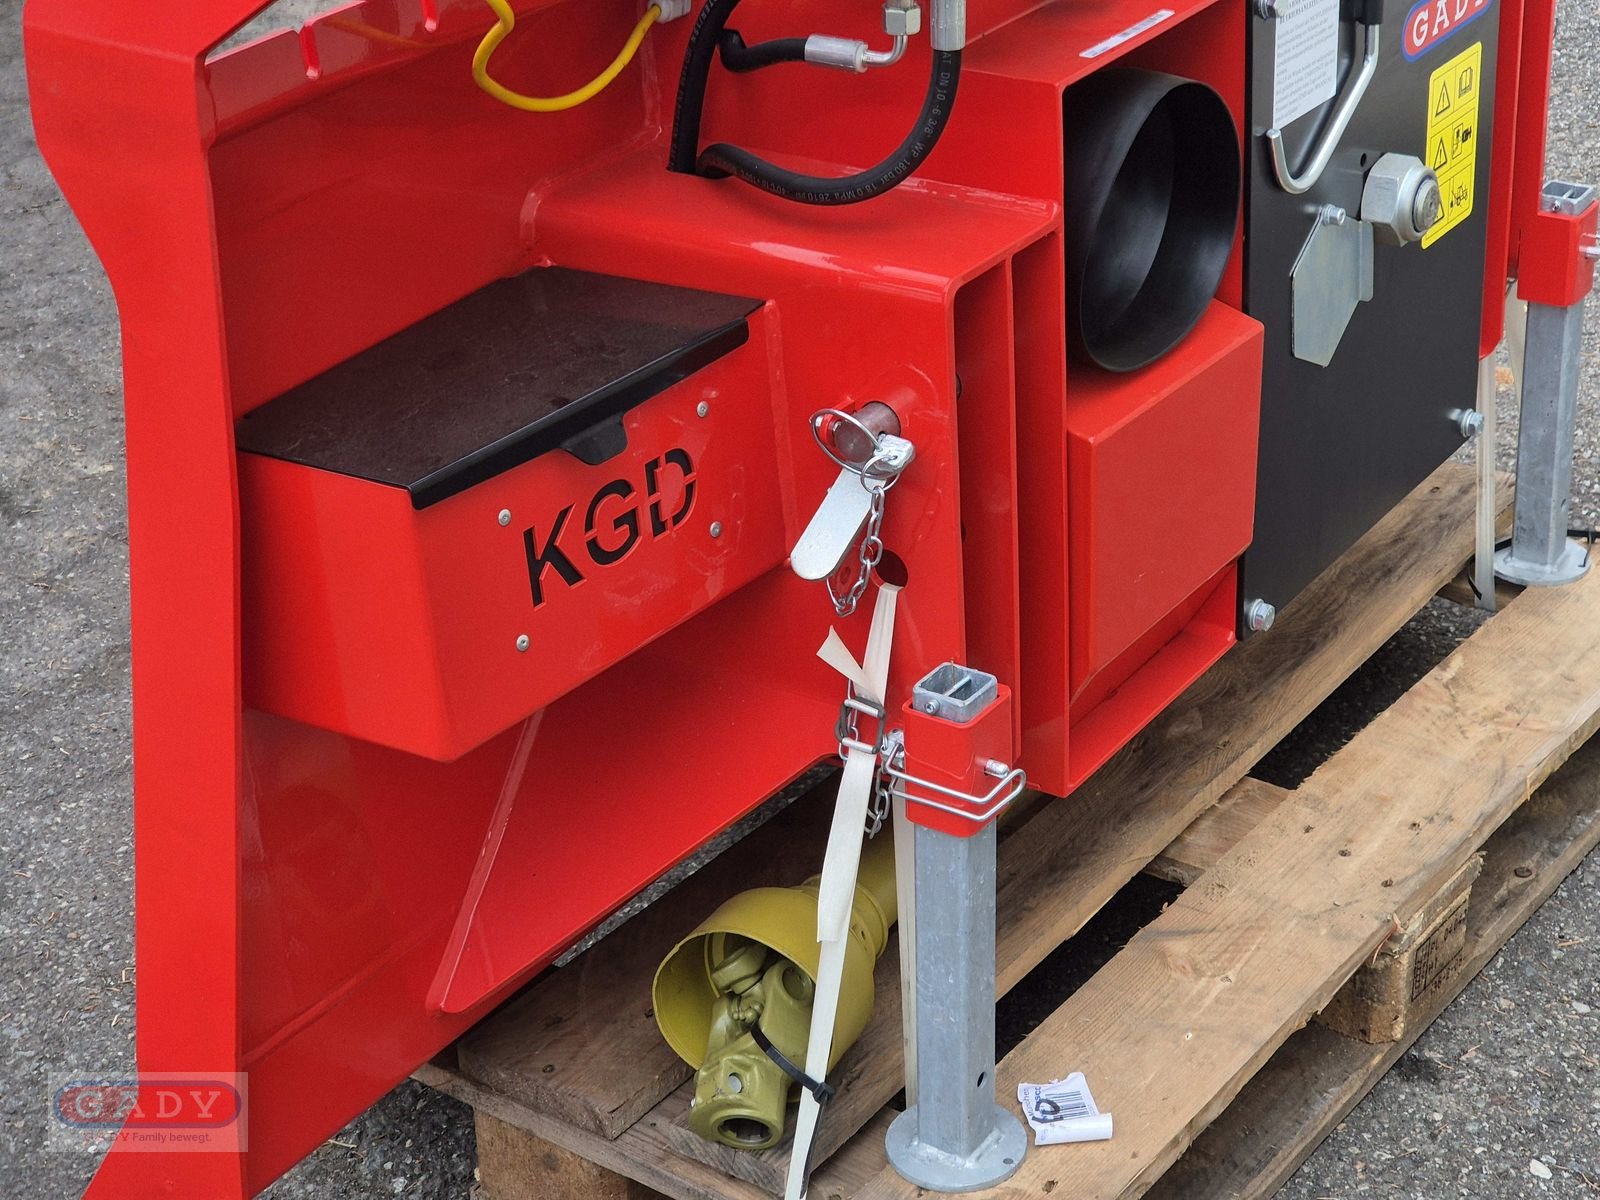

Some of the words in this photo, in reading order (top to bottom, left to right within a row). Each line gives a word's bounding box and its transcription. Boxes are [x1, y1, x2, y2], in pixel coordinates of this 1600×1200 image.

[1413, 0, 1483, 47] GAD
[940, 72, 951, 87] DN
[911, 142, 926, 158] WP
[894, 159, 911, 174] 180
[880, 171, 896, 185] bar
[807, 191, 831, 201] 2610
[523, 448, 697, 608] KGD
